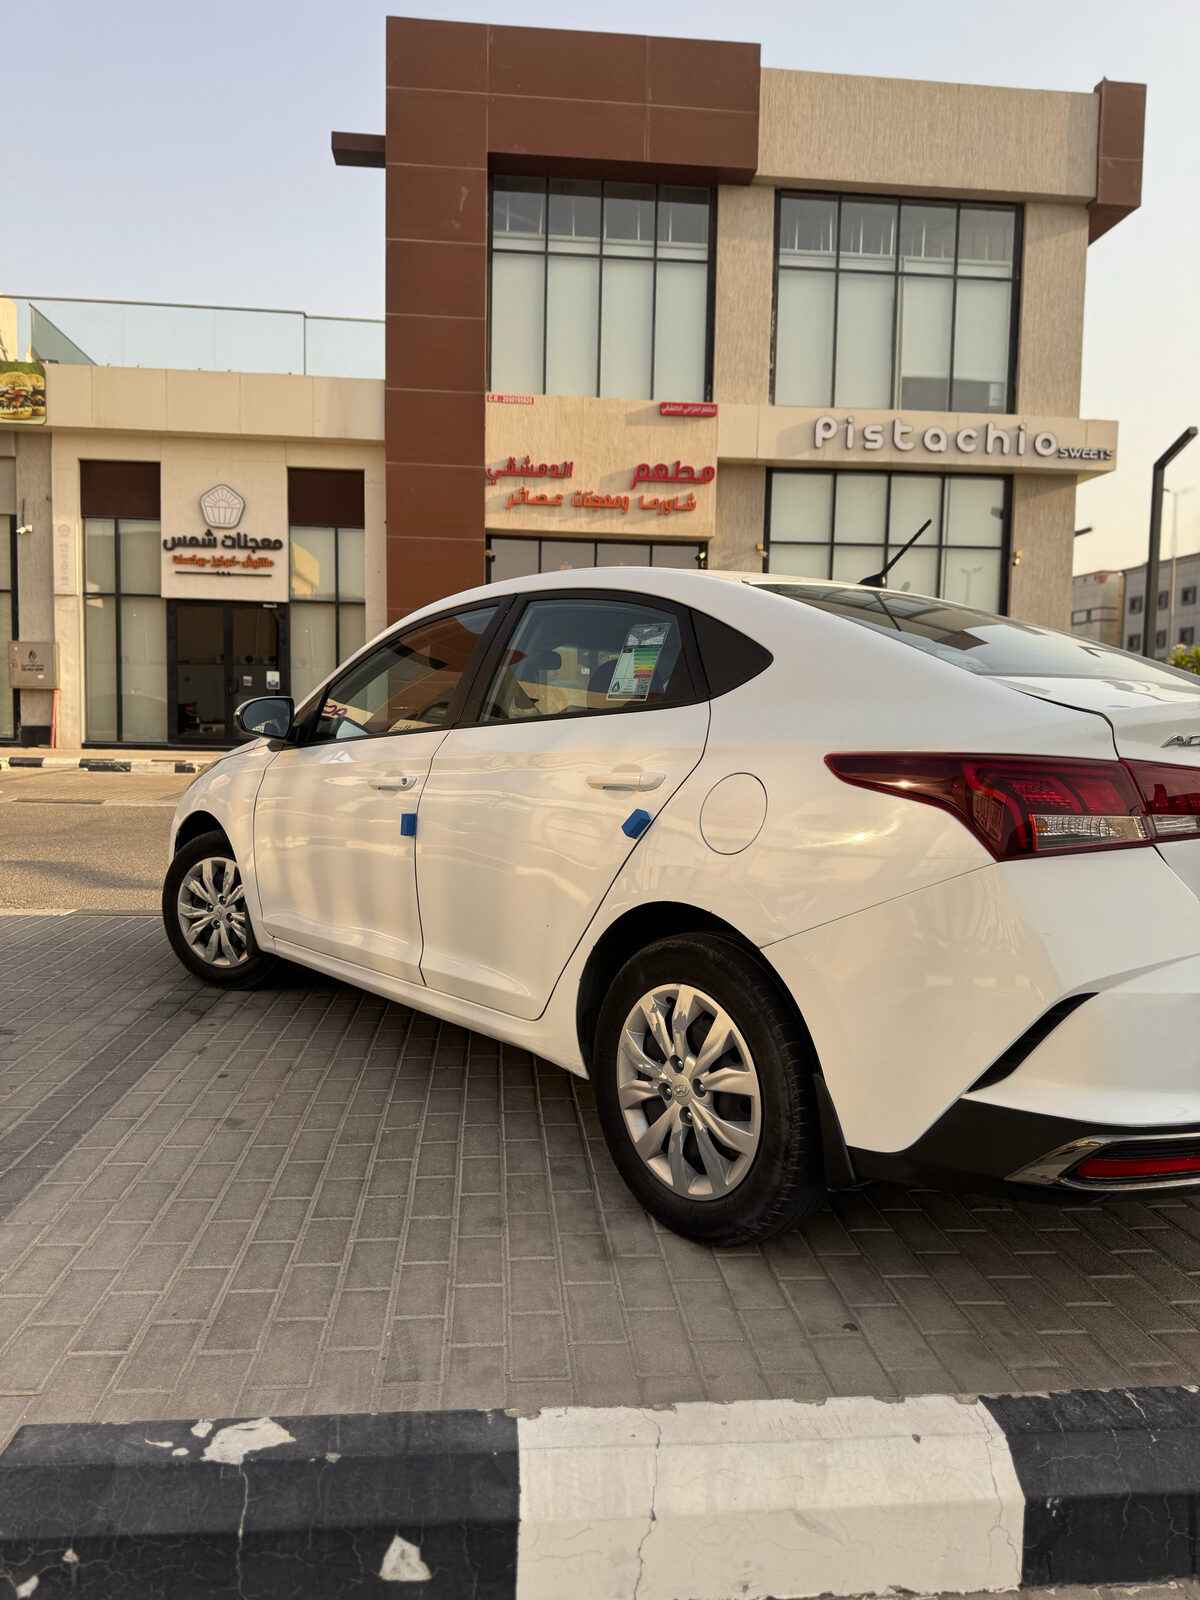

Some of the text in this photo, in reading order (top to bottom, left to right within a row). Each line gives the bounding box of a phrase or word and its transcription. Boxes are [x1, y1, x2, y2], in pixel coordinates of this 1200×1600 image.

[814, 415, 1113, 460] Pistachio SWEETS
[487, 455, 716, 489] مطعم الدمشقي
[505, 487, 697, 515] شاورما ومعجنات عصائر
[163, 529, 283, 553] معجنات شمس
